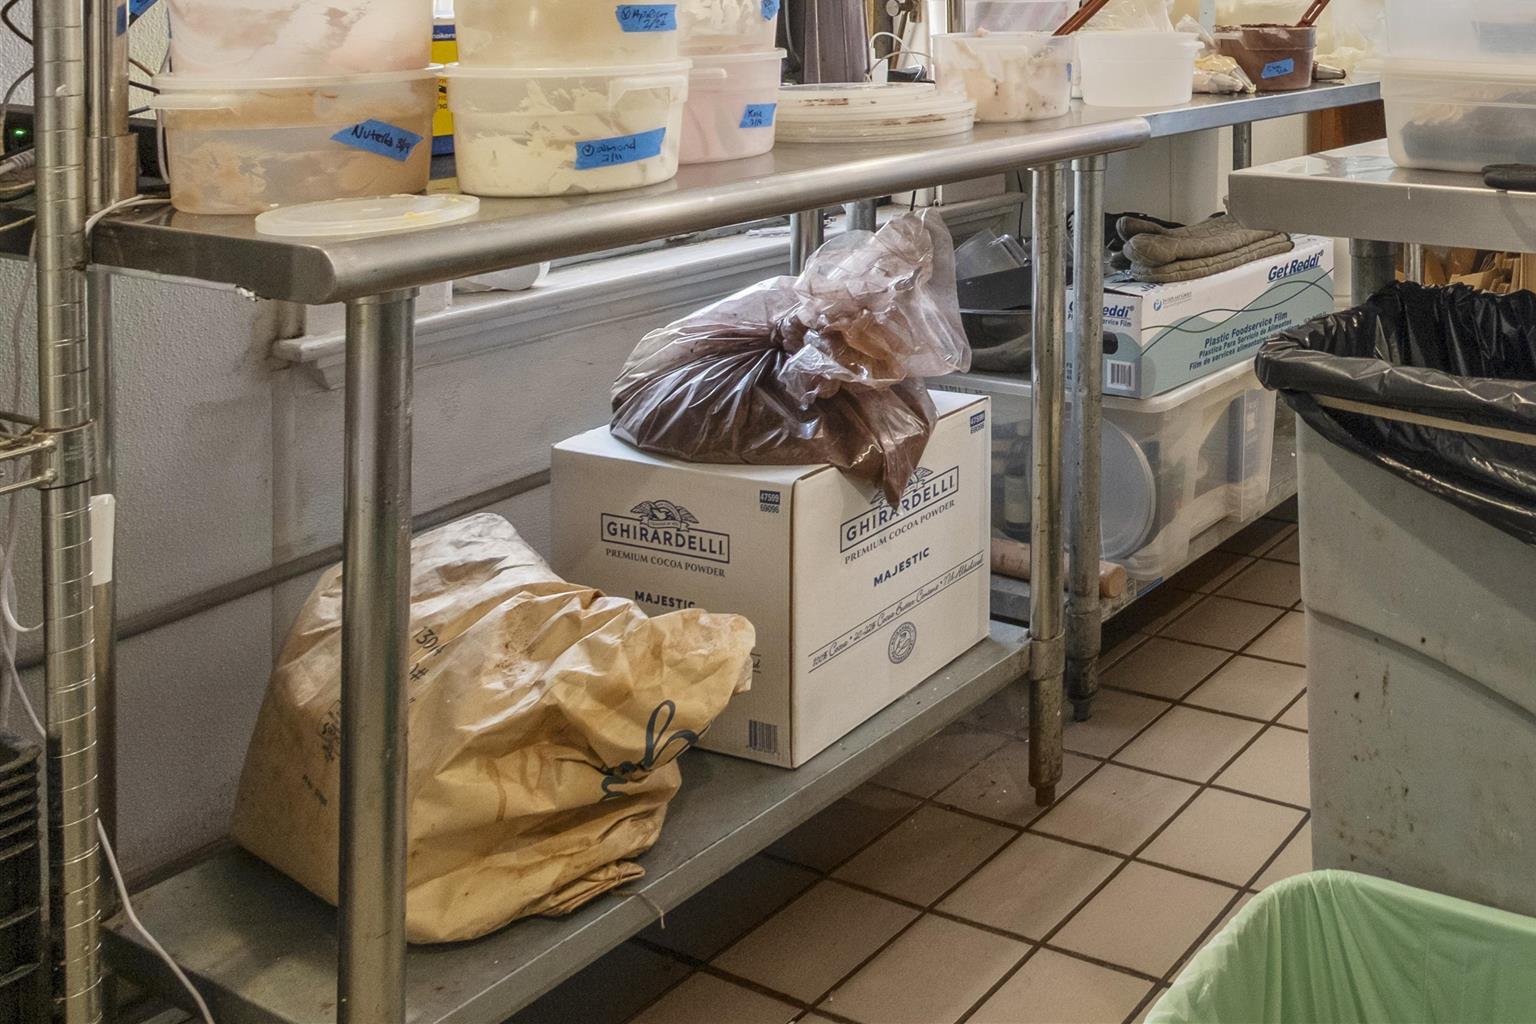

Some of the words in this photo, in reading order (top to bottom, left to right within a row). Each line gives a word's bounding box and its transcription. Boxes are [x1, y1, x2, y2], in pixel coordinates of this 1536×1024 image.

[351, 124, 393, 147] Nutella
[1204, 332, 1230, 348] Plastic
[1231, 318, 1272, 338] Foodservice
[1273, 311, 1288, 323] Film
[1189, 359, 1202, 371] Film
[1203, 356, 1211, 365] de
[1212, 349, 1235, 363] services
[846, 475, 954, 542] GHIRARDELLI
[606, 521, 724, 556] GHIRARDELLI
[845, 538, 887, 564] PREMIUM
[888, 521, 918, 539] COCOA
[920, 499, 955, 524] POWDER
[605, 548, 649, 564] PREMIUM
[650, 557, 684, 570] COCOA
[684, 562, 726, 577] POWDER
[873, 547, 930, 587] MAJESTIC
[635, 590, 696, 609] MAJESTIC
